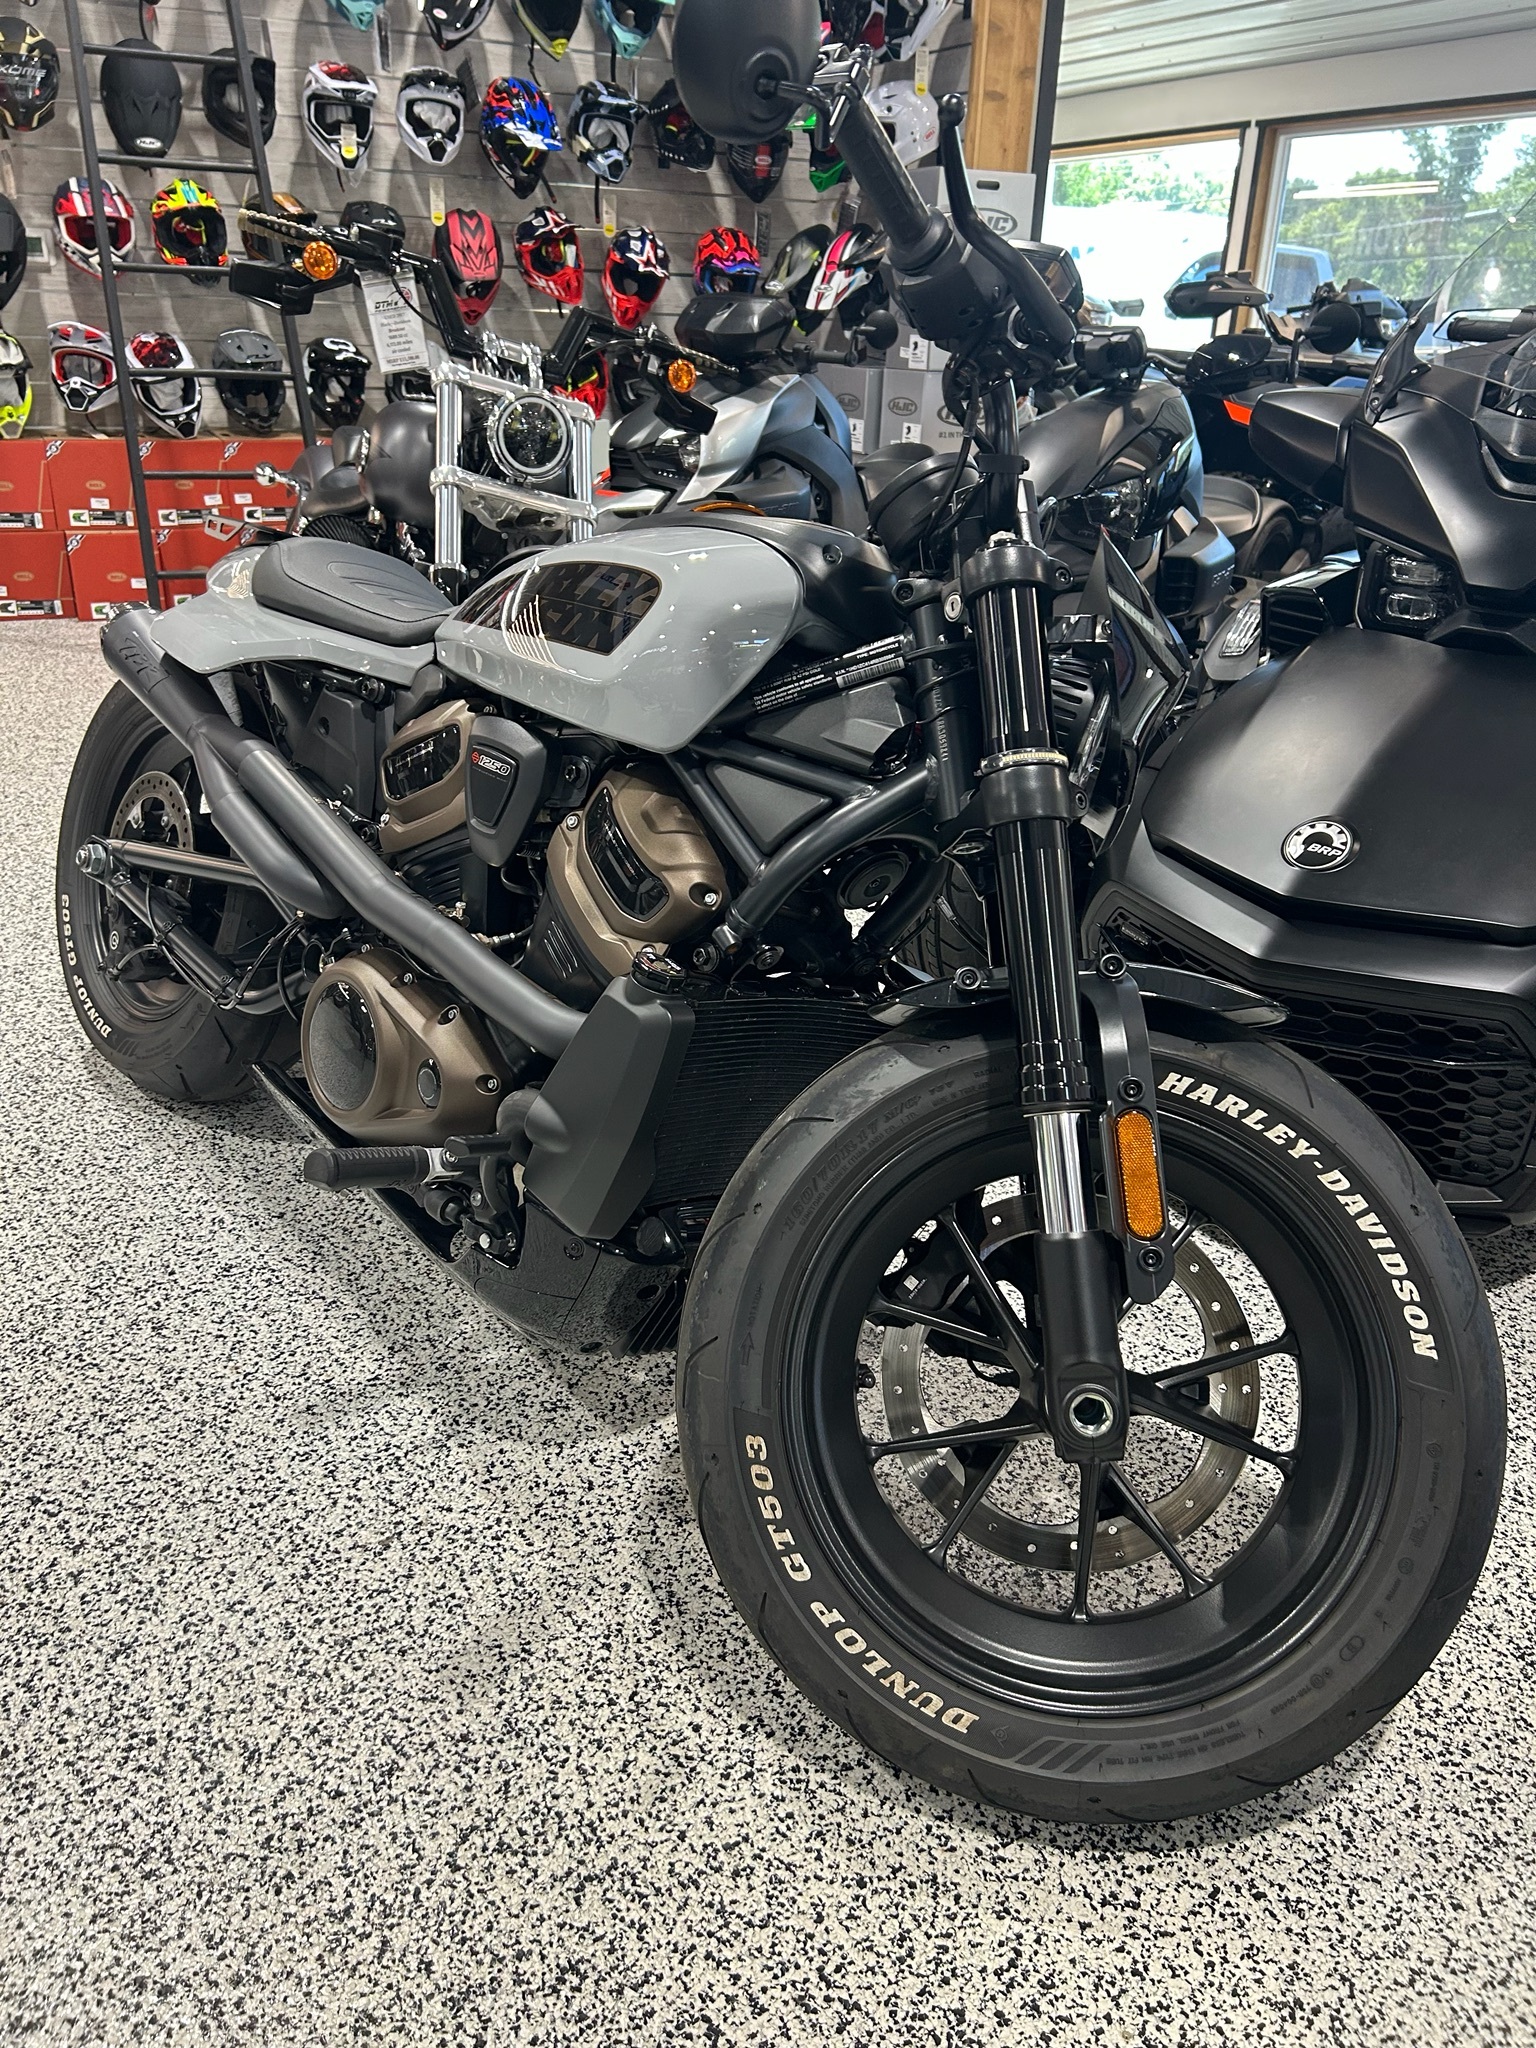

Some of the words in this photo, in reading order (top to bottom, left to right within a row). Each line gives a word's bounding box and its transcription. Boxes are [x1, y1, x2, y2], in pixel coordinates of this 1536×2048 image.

[479, 755, 511, 776] 1250
[1307, 843, 1343, 857] BRP
[61, 894, 77, 966] GT503
[72, 974, 113, 1038] DUNLOP
[824, 1165, 849, 1193] RUBBER
[1157, 1071, 1439, 1362] HARLEY-DAVIDSON
[745, 1434, 812, 1582] GT503
[810, 1600, 980, 1734] DUNLOP
